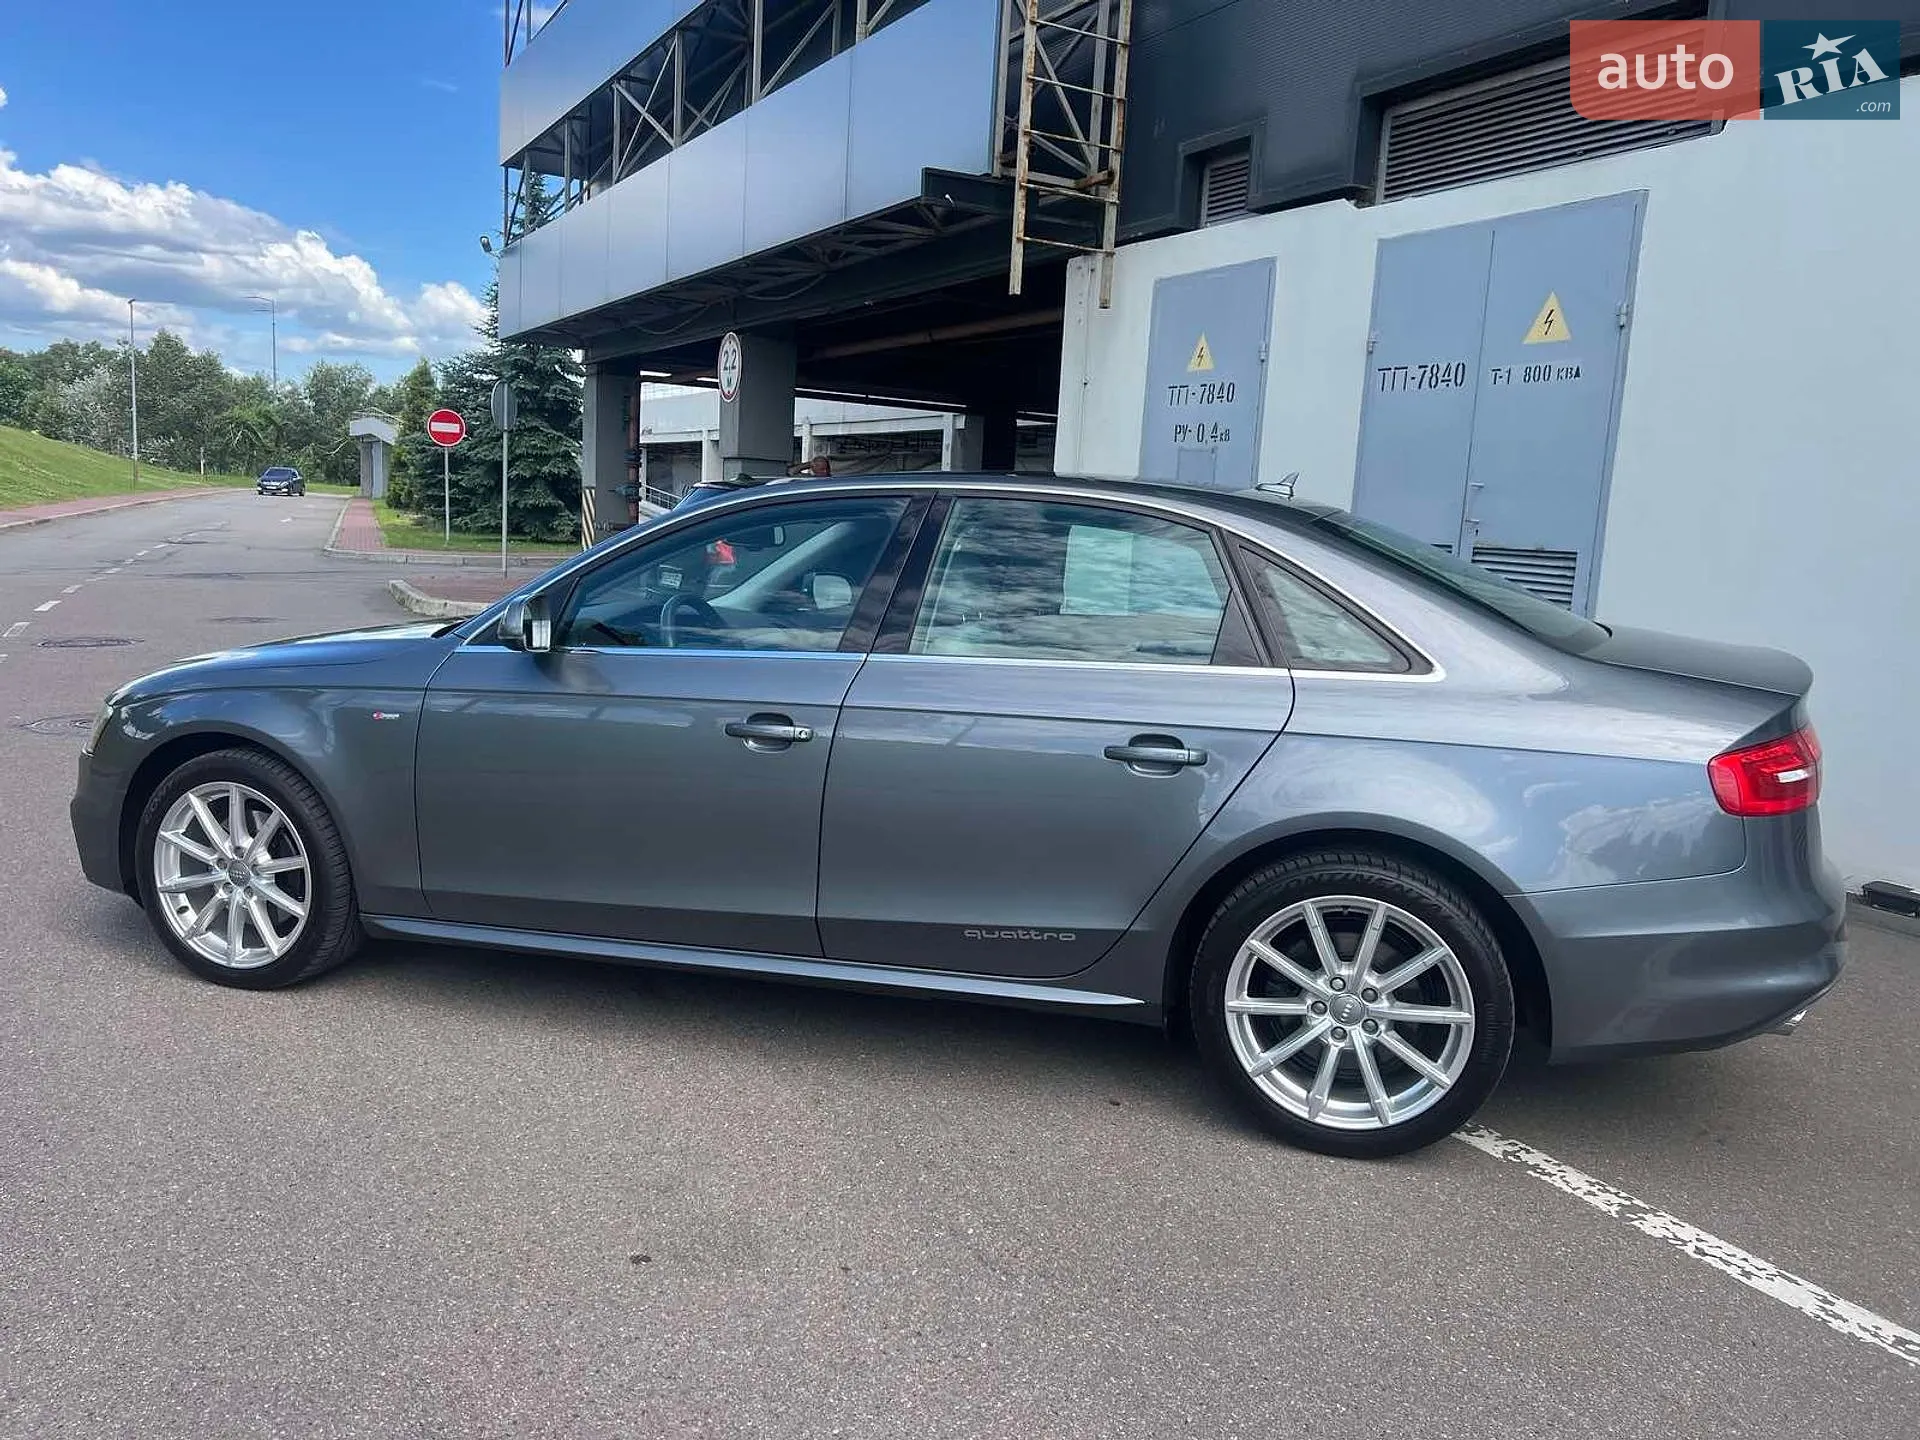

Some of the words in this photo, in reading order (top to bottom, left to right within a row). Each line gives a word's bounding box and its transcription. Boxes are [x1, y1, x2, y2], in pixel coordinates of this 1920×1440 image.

[1378, 362, 1466, 392] ТП-7840
[1523, 364, 1552, 383] 800
[1168, 382, 1235, 406] ТП-7840
[963, 929, 1076, 941] quattro
